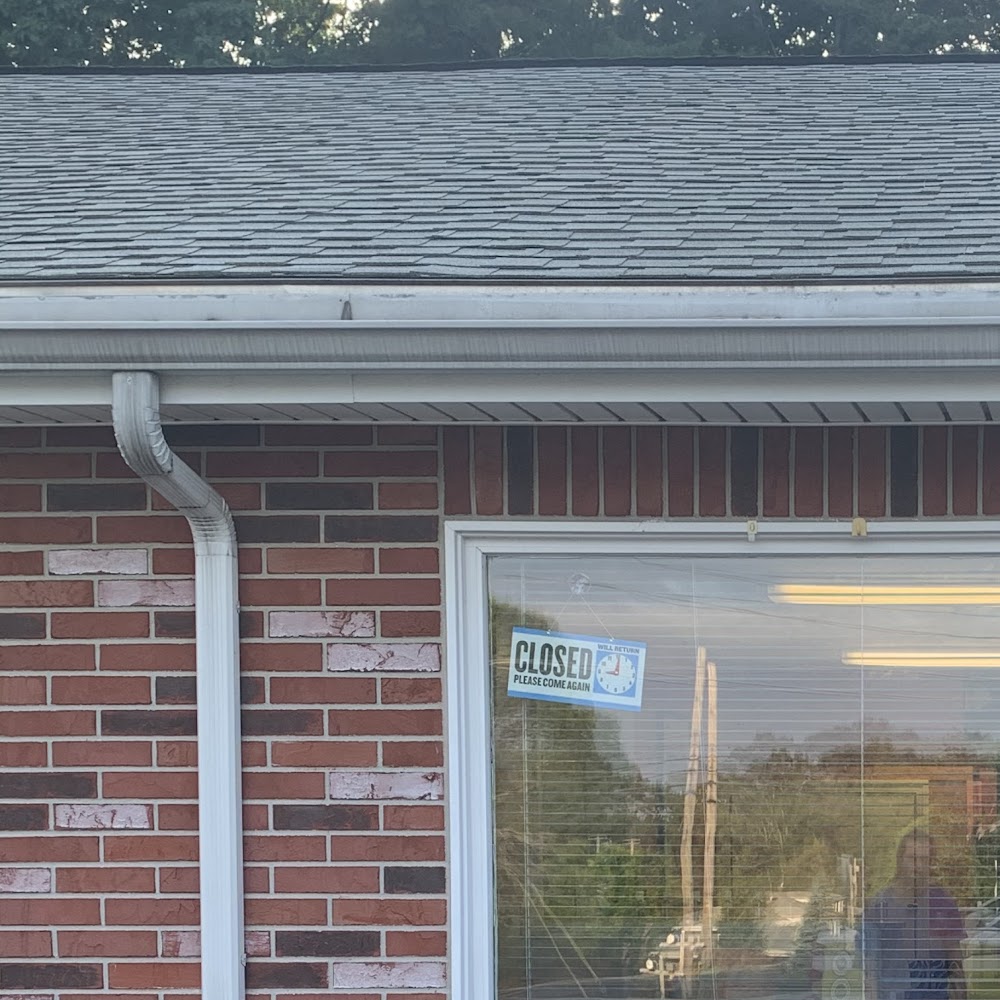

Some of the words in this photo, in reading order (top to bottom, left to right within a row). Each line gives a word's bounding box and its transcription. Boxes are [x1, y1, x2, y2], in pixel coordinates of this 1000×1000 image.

[597, 643, 614, 652] WILL
[614, 645, 640, 654] RETURN
[514, 640, 593, 680] CLOSED
[513, 674, 542, 687] PLEASE
[542, 677, 566, 689] COME
[566, 679, 591, 692] AGAIN
